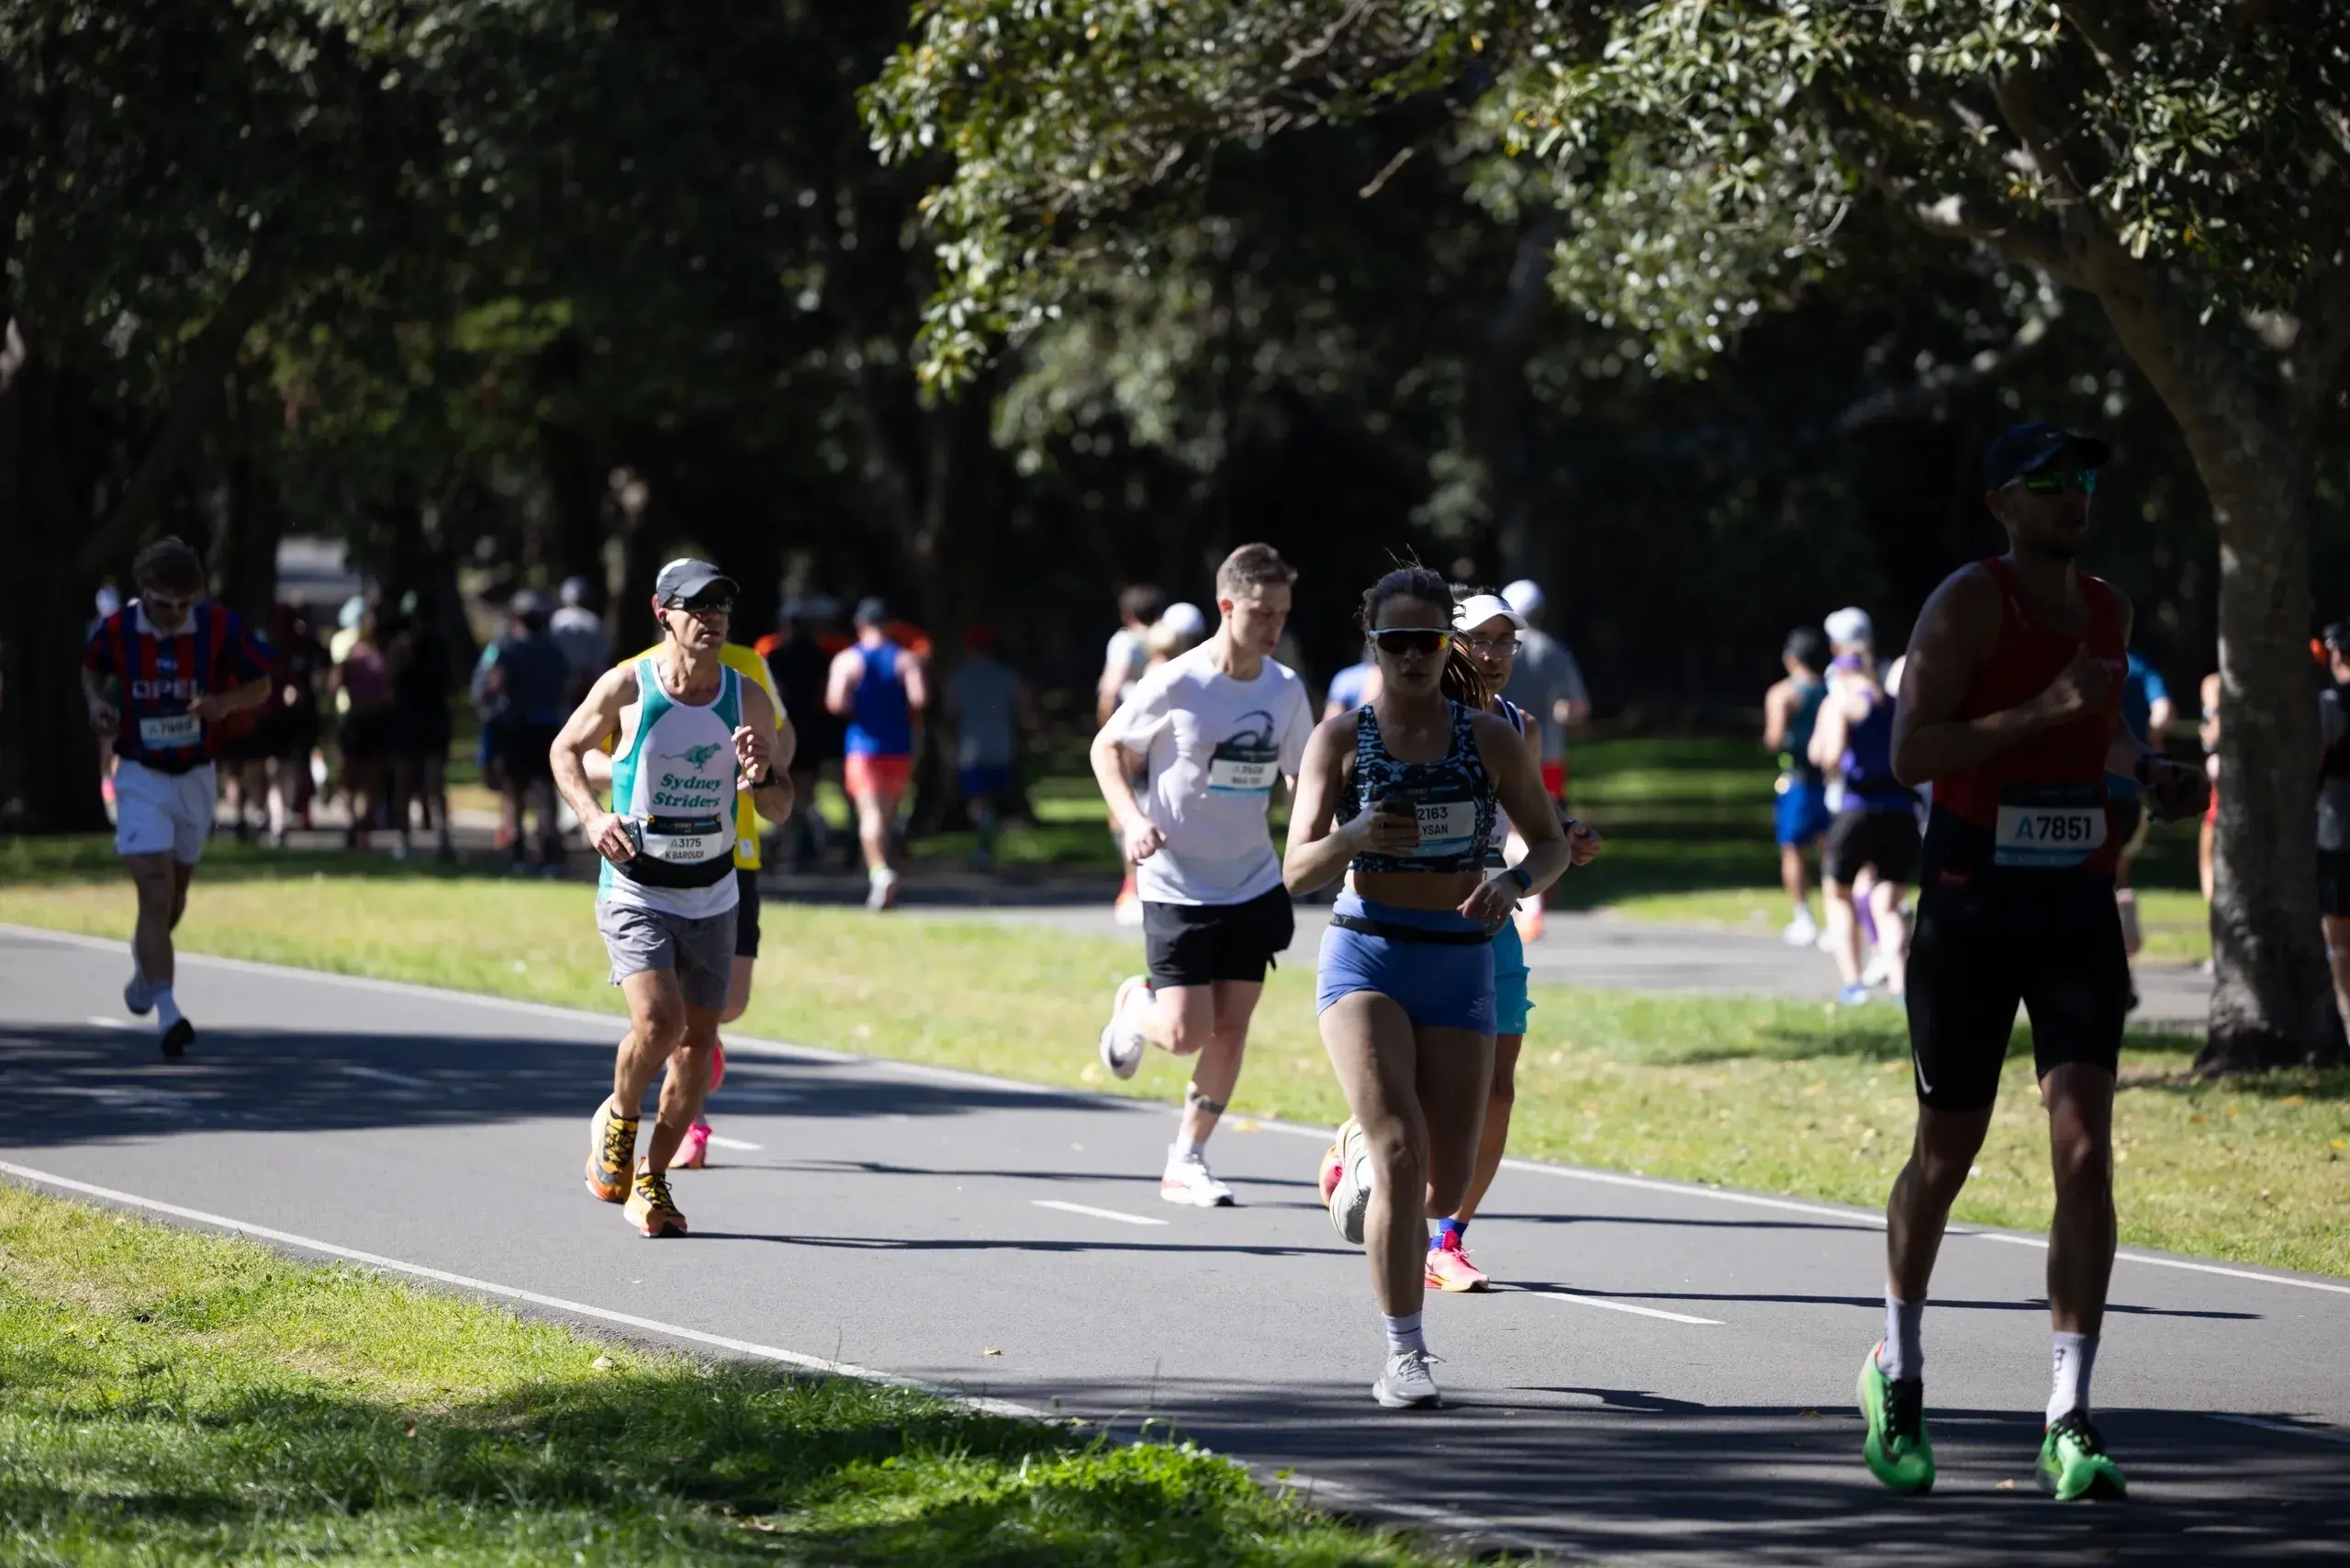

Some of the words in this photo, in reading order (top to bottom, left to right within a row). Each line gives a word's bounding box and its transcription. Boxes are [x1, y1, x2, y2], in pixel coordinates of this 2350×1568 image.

[660, 773, 722, 791] Sydney
[653, 792, 721, 808] Striders
[1417, 807, 1449, 821] 2163
[1421, 824, 1449, 835] YSAN
[2015, 815, 2091, 841] A7851
[670, 837, 702, 848] A3175
[666, 851, 671, 859] K
[672, 850, 704, 859] BAROUDI
